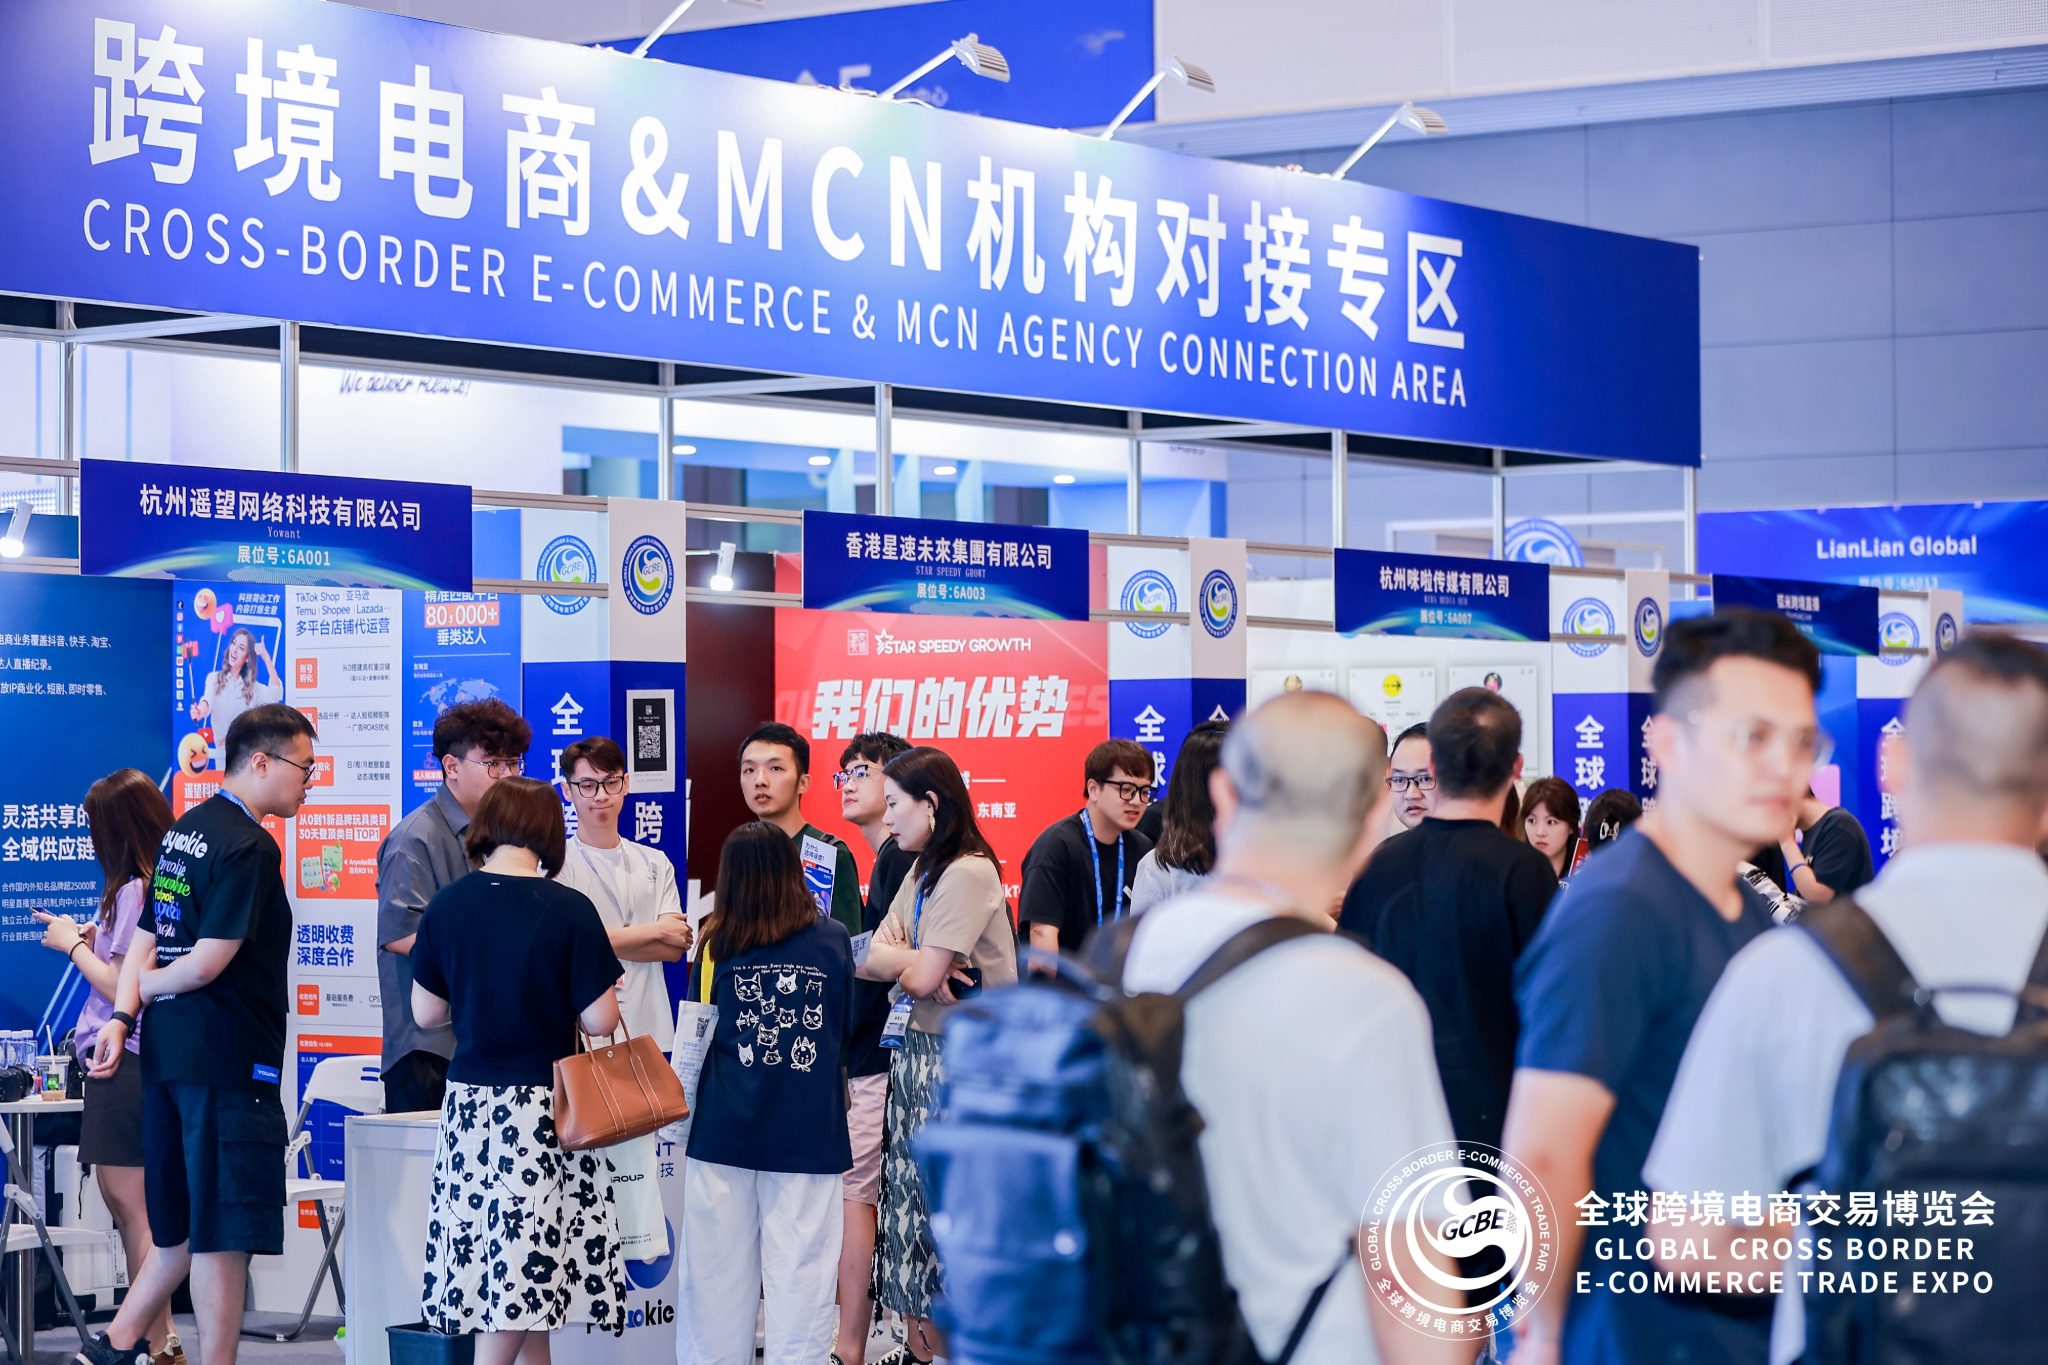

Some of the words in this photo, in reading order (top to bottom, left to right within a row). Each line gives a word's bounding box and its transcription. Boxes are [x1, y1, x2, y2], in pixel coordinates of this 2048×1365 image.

[88, 17, 1465, 349] 跨境电商&MCN机构对接专区
[83, 198, 506, 298] CROSS-BORDER
[532, 254, 831, 335] E-COMMERCE
[852, 293, 876, 341] &
[898, 299, 978, 351] MCN
[998, 312, 1143, 369] AGENCY
[1160, 331, 1378, 398] CONNECTION
[1392, 361, 1466, 408] AREA
[139, 483, 422, 531] 杭州遥望网络科技有限公司
[267, 526, 300, 539] Yowant
[845, 531, 1053, 570] 香港星速未來集團有限公司
[1816, 537, 1904, 559] LianLian
[1909, 534, 1978, 557] Global
[915, 565, 933, 576] STAR
[936, 566, 961, 577] SPEEDY
[1379, 566, 1509, 598] 杭州咪啦传媒有限公司
[295, 592, 319, 603] TikTok
[320, 592, 340, 603] Shop
[295, 606, 317, 616] Temu
[321, 605, 351, 617] Shopee
[295, 617, 390, 637] 多平台店铺代运营
[437, 627, 487, 646] 垂类达人
[884, 639, 917, 654] STAR
[918, 639, 967, 654] SPEEDY
[969, 637, 1032, 652] GROWTH
[811, 675, 1069, 739] 我们的优势
[977, 802, 1017, 818] 东南亚
[296, 925, 354, 945] 透明收费
[296, 947, 354, 967] 深度合作
